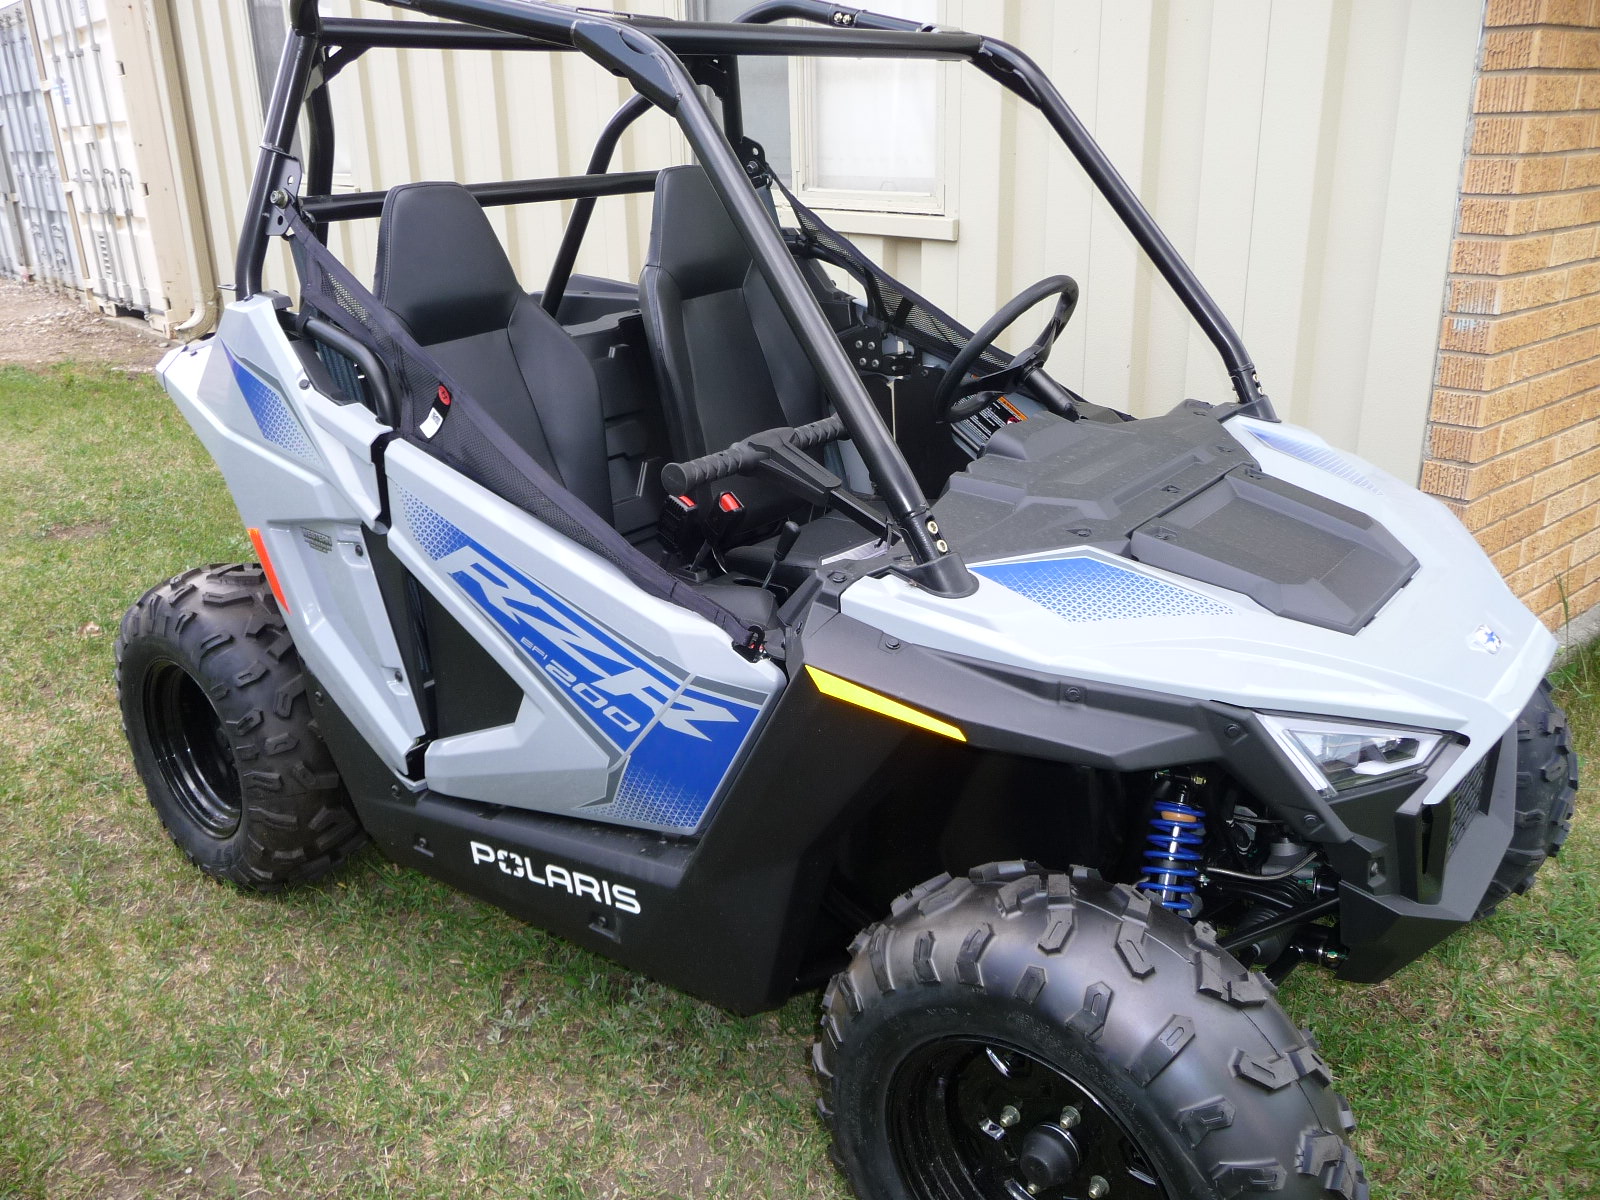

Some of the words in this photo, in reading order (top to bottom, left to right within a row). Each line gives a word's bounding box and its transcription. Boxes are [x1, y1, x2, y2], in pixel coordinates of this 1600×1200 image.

[437, 546, 740, 742] RZR
[520, 637, 548, 661] EFI
[545, 659, 641, 732] 200
[470, 841, 642, 915] POLARIS
